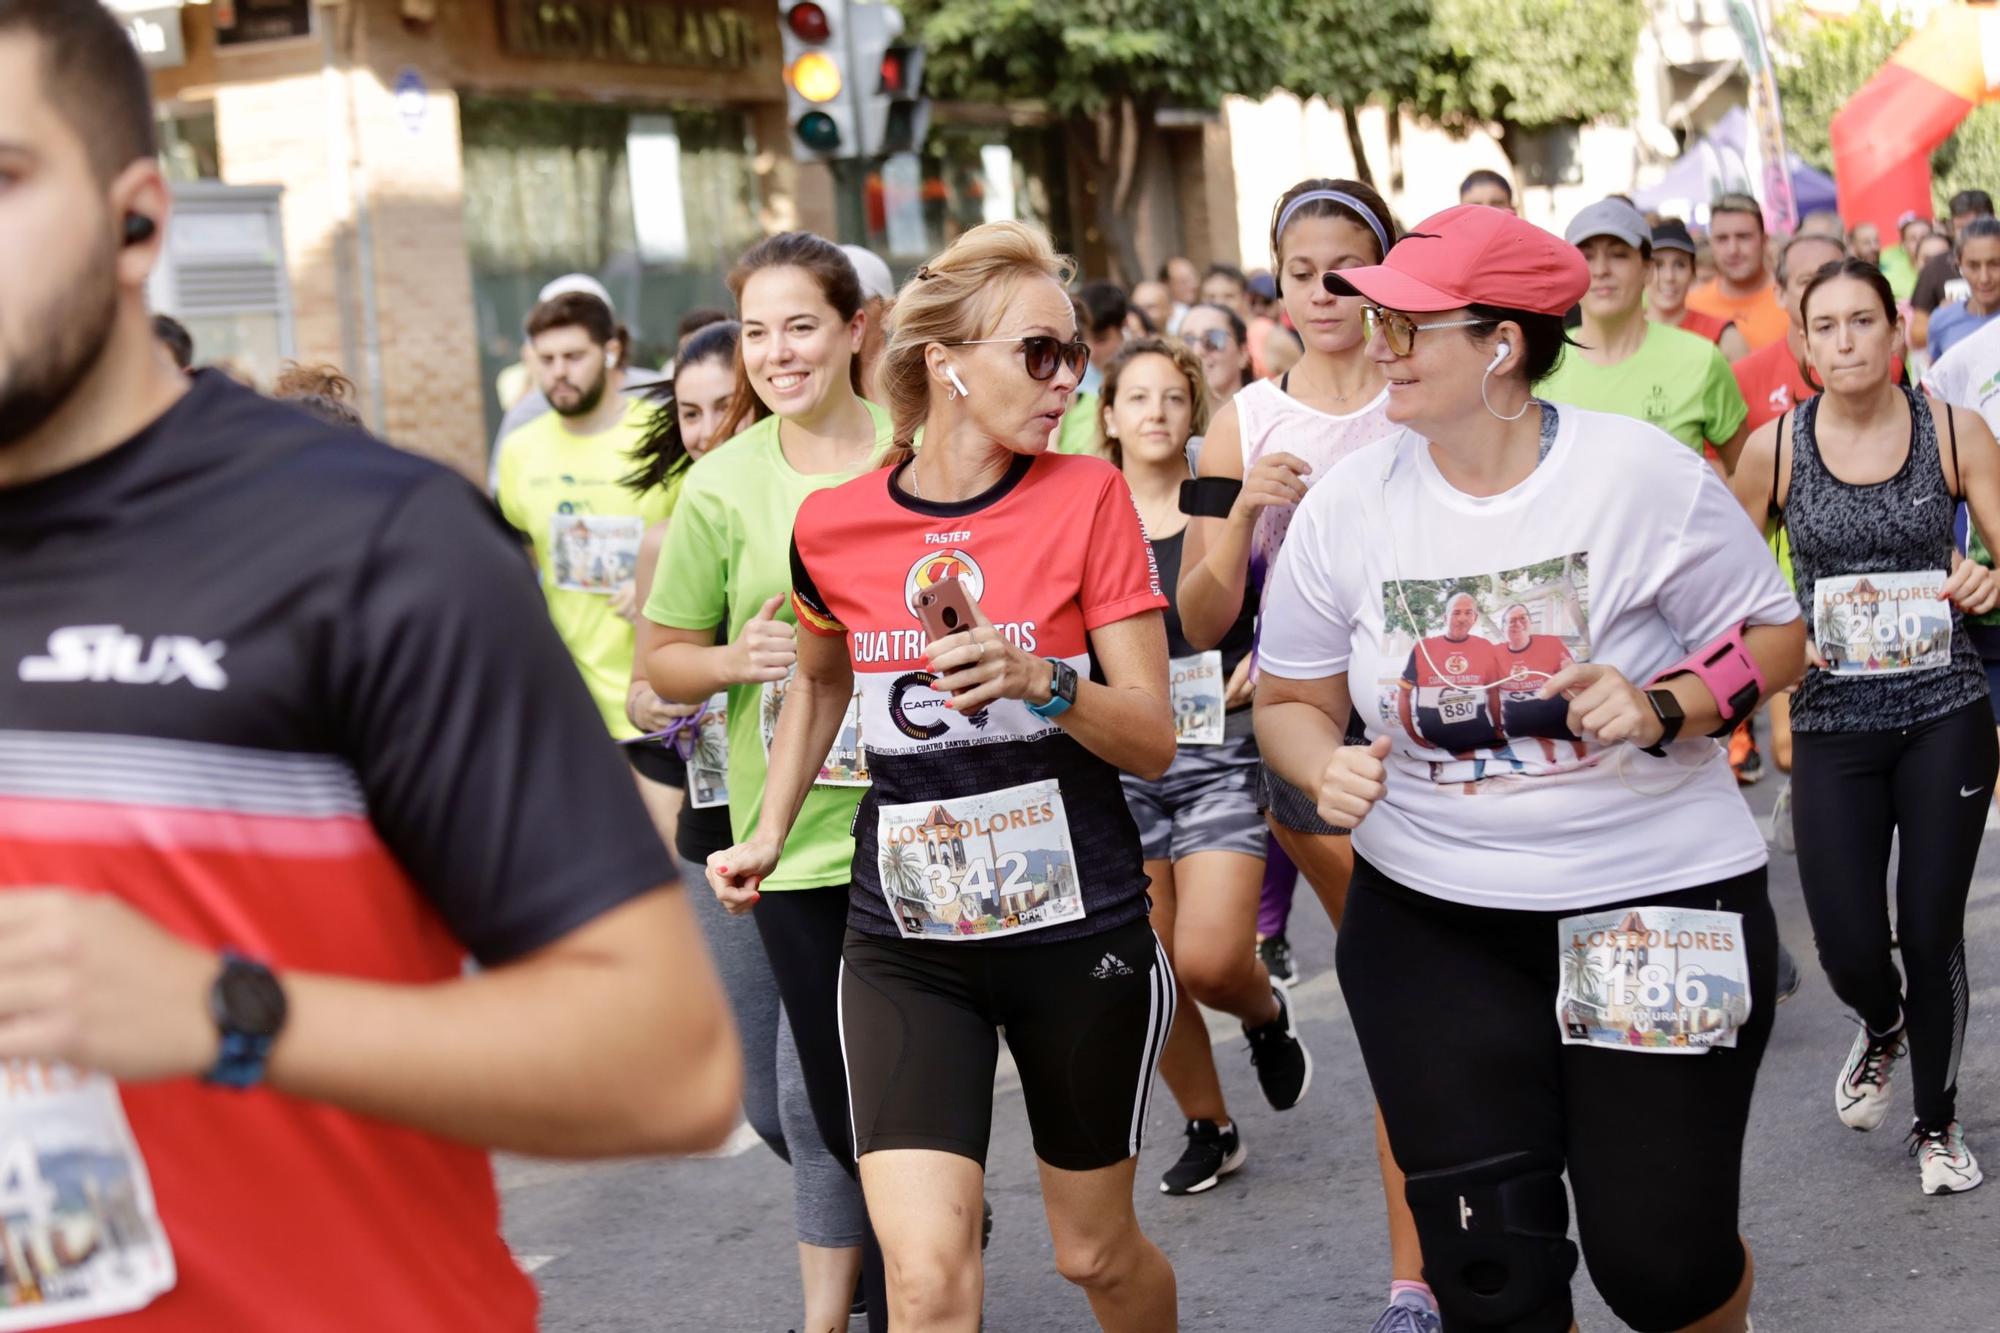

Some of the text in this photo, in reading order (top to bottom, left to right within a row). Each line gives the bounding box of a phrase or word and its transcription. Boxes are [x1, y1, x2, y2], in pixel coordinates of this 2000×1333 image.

[924, 530, 971, 544] FASTER
[1823, 586, 1940, 609] LOS DOLORES
[1848, 612, 1922, 644] 260
[1445, 702, 1474, 718] 880
[916, 742, 944, 754] CUATRO
[945, 738, 971, 750] SANTOS
[972, 734, 1009, 746] CARTAGENA
[887, 823, 930, 847] LOS
[935, 801, 1057, 842] DOLORES
[921, 850, 1033, 906] 342
[1571, 928, 1736, 952] LOS DOLORES
[1602, 963, 1709, 1008] 186
